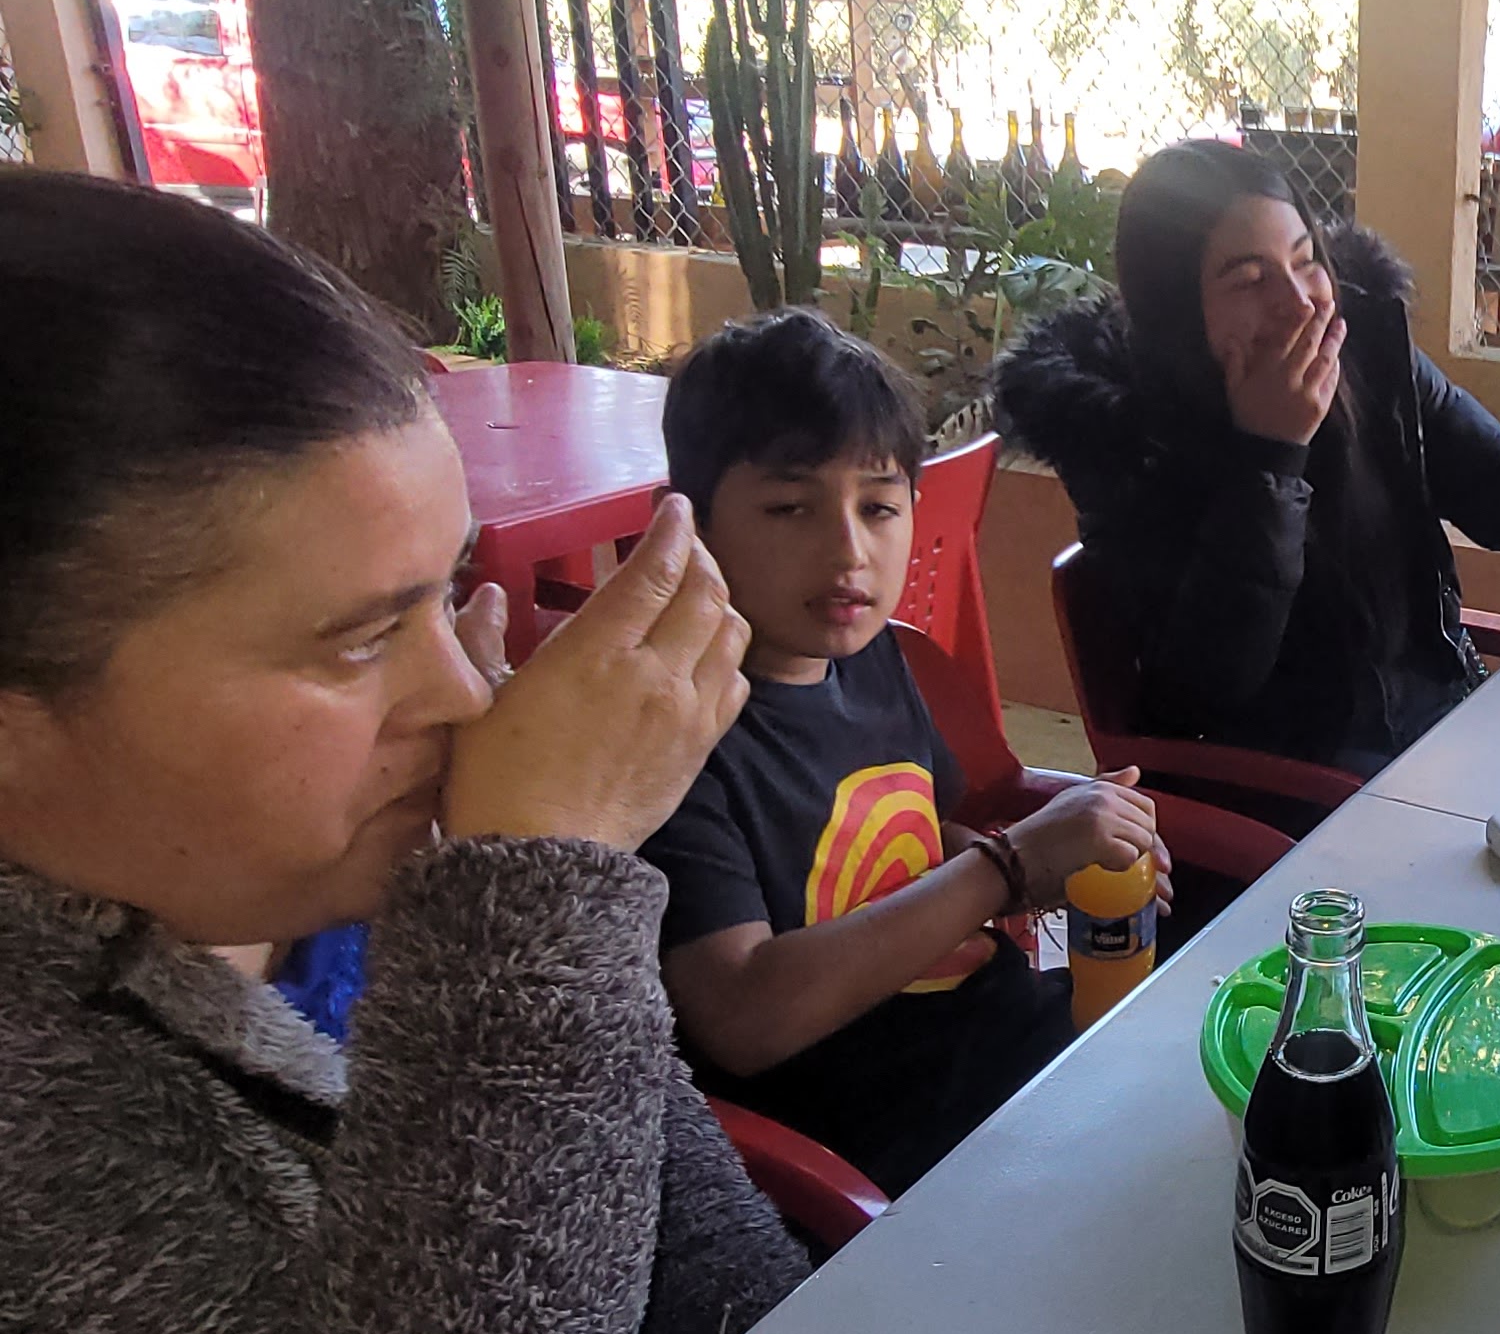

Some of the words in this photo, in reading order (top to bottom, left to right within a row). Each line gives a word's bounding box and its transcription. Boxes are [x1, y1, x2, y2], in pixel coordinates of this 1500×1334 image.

[1331, 1186, 1367, 1204] Coke
[1264, 1205, 1302, 1224] EXCESO
[1258, 1214, 1308, 1236] AZUCARES
